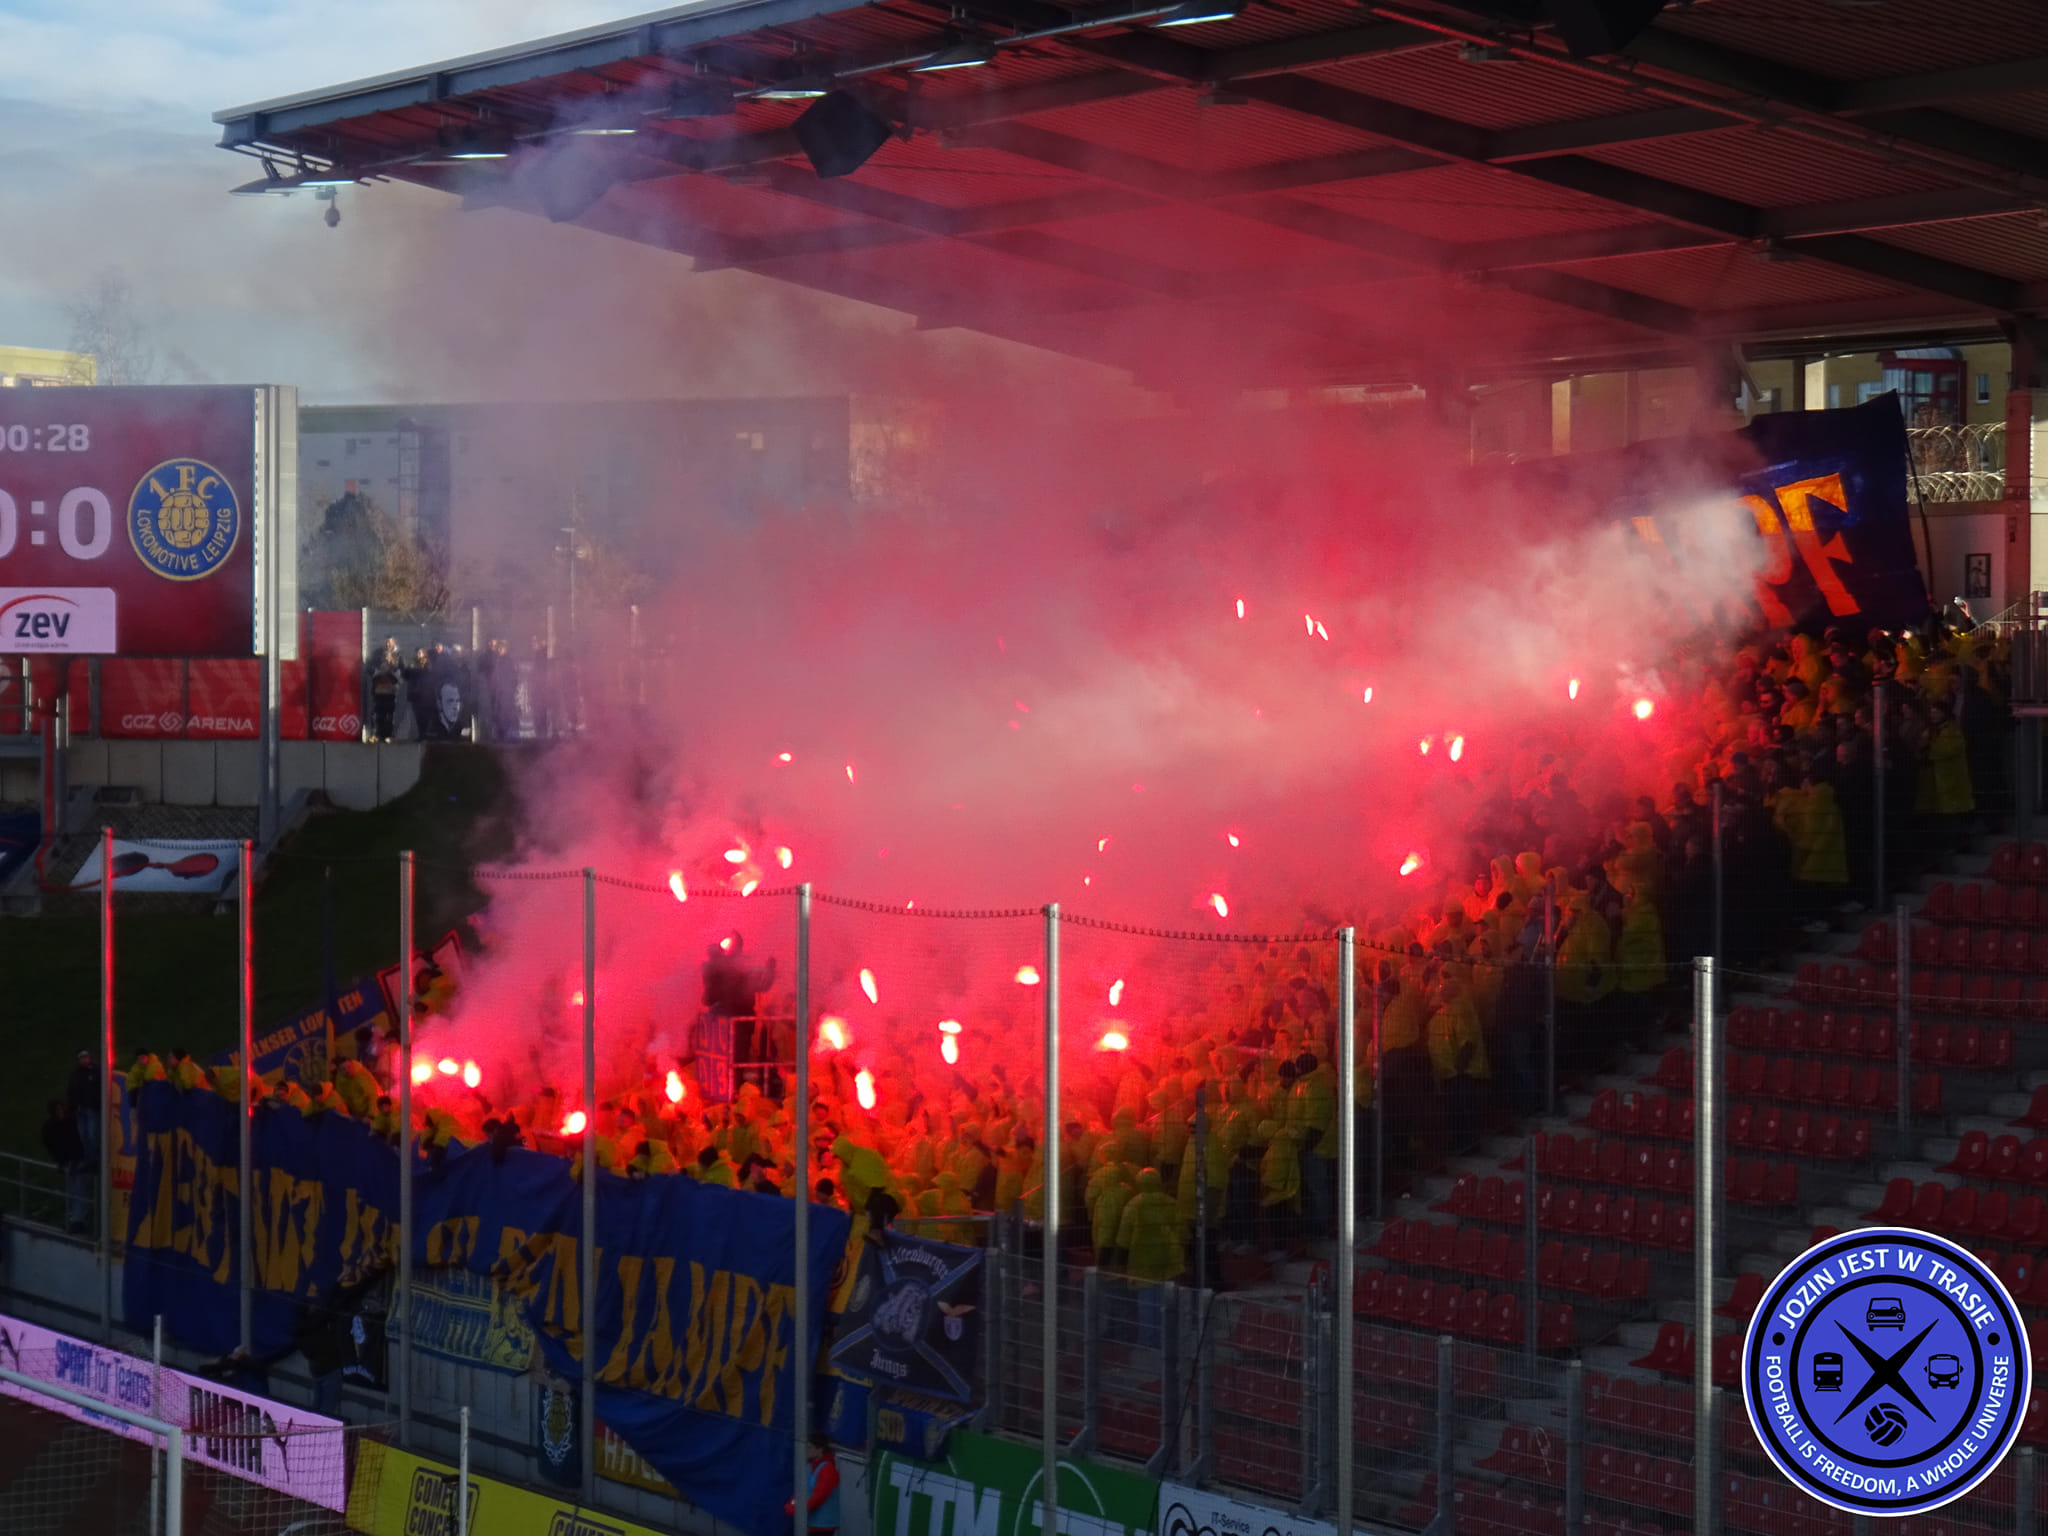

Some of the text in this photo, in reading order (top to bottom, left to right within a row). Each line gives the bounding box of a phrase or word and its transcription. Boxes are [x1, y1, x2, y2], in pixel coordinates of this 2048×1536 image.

[137, 508, 232, 571] LOKOMOTIVE LEIPZIG
[15, 612, 70, 638] zev
[121, 715, 254, 731] GGZ ARENA
[312, 716, 338, 731] GGZ
